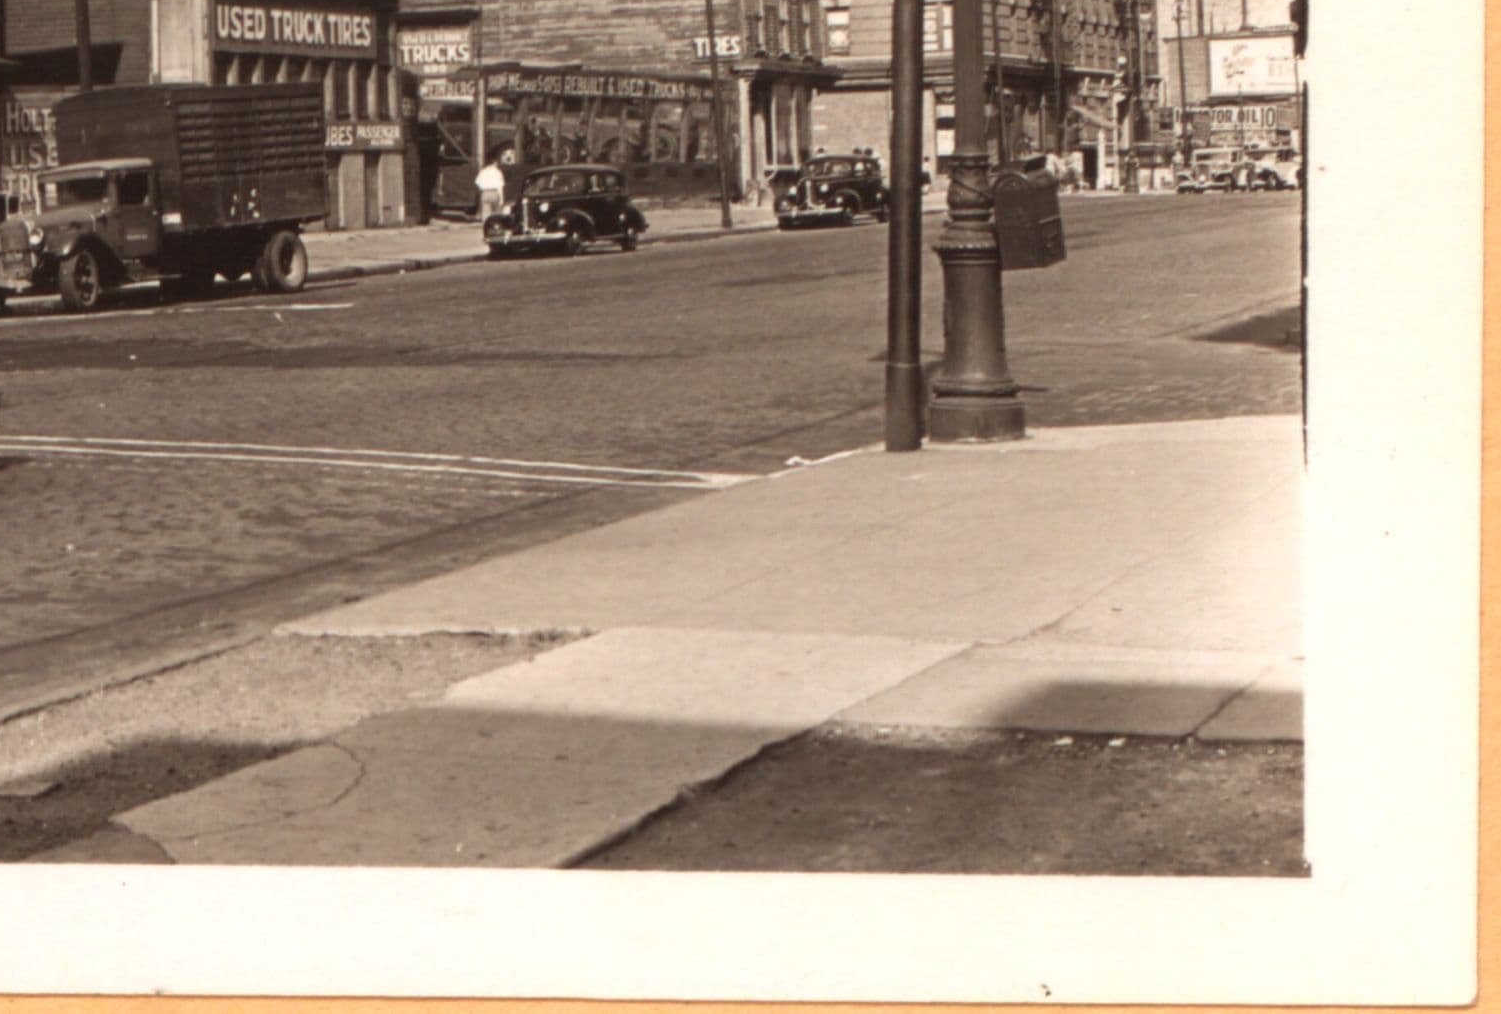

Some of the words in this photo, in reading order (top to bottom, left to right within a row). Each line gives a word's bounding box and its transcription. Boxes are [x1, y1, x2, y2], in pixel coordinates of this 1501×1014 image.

[217, 4, 266, 40] USED
[271, 9, 325, 44] TRUCK
[327, 15, 371, 47] TIRES
[401, 44, 470, 64] TRUCKS
